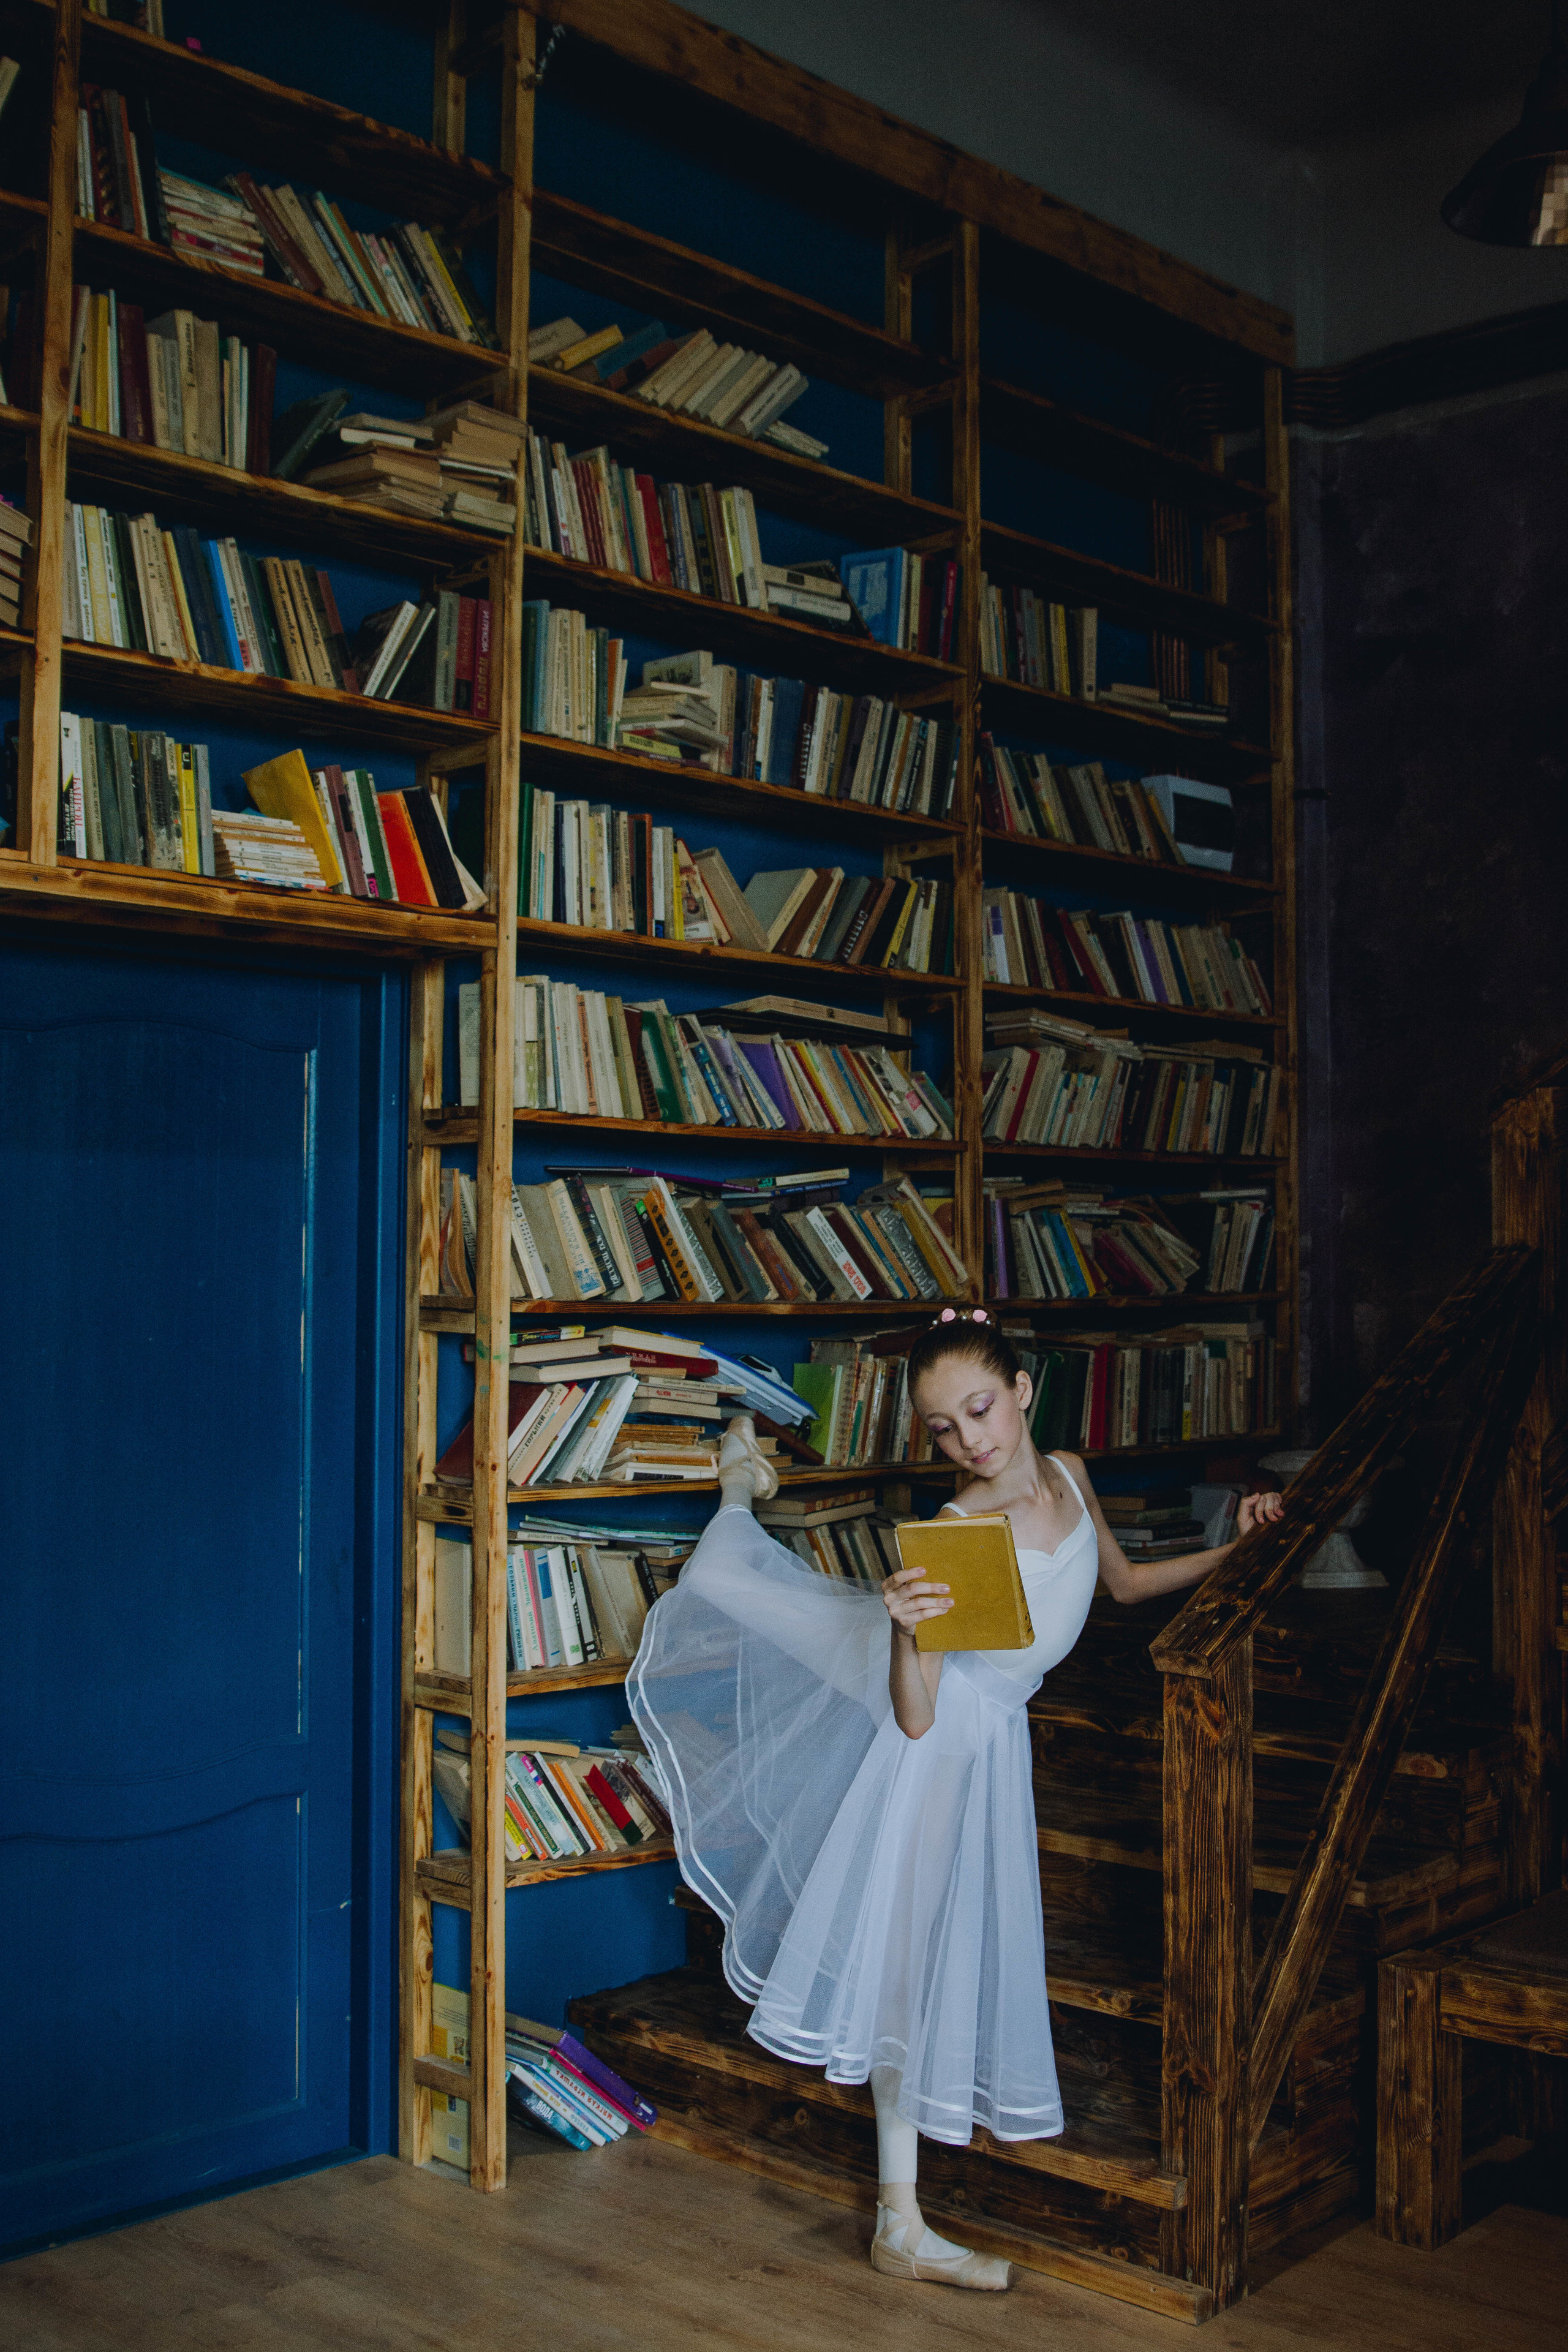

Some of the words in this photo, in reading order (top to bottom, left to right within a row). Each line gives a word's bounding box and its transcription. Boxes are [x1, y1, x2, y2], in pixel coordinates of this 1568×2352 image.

[518, 1557, 532, 1607] Знаменский
[526, 1610, 539, 1652] Анатолий
[552, 2067, 586, 2098] ИГРУШКА
[532, 2098, 556, 2121] ВОДА
[585, 2094, 614, 2122] МЯГКАЯ
